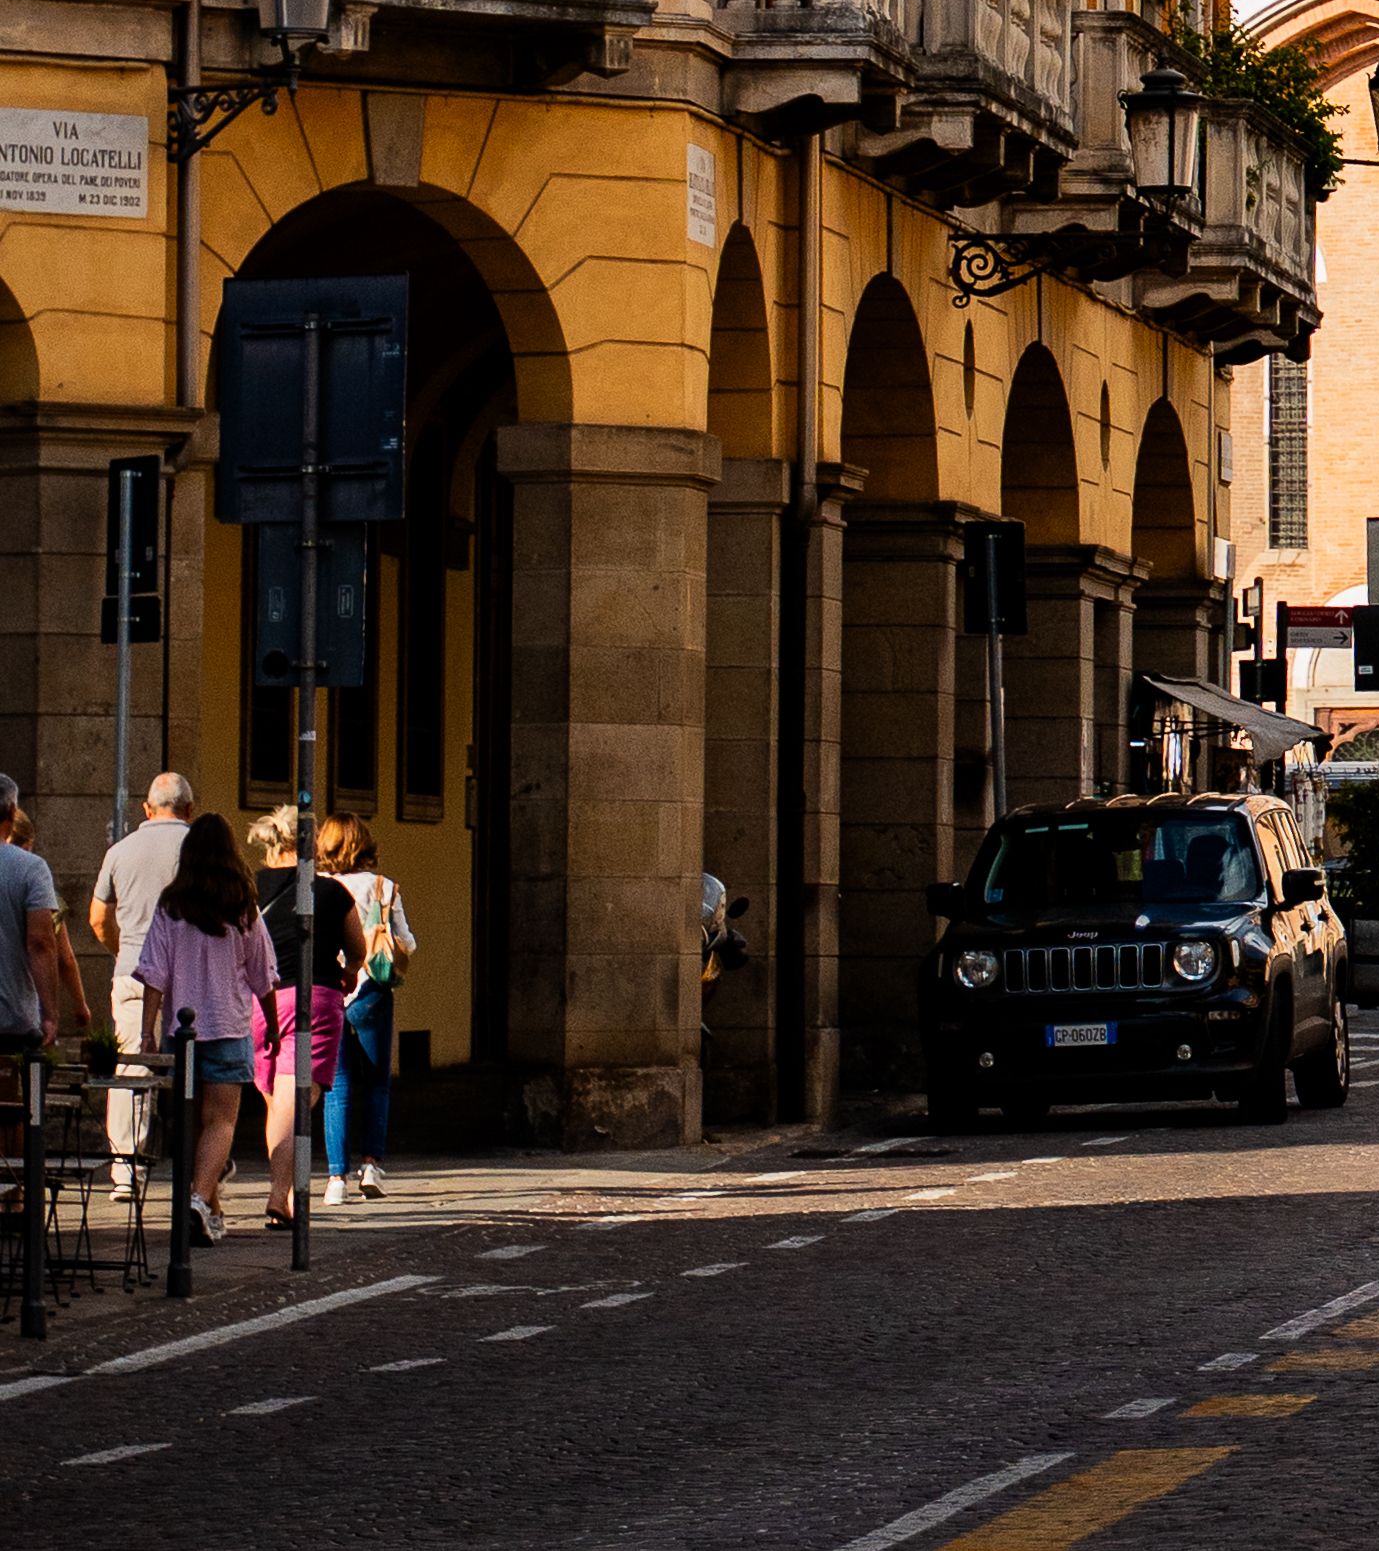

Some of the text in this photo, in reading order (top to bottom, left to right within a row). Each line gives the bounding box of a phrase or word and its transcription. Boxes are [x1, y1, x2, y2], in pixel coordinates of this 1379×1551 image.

[53, 121, 79, 140] VIA
[61, 147, 142, 170] LOCATELLI
[32, 172, 58, 185] OPERA
[61, 174, 77, 186] DEL
[103, 195, 118, 206] DIC
[120, 196, 141, 207] 1902
